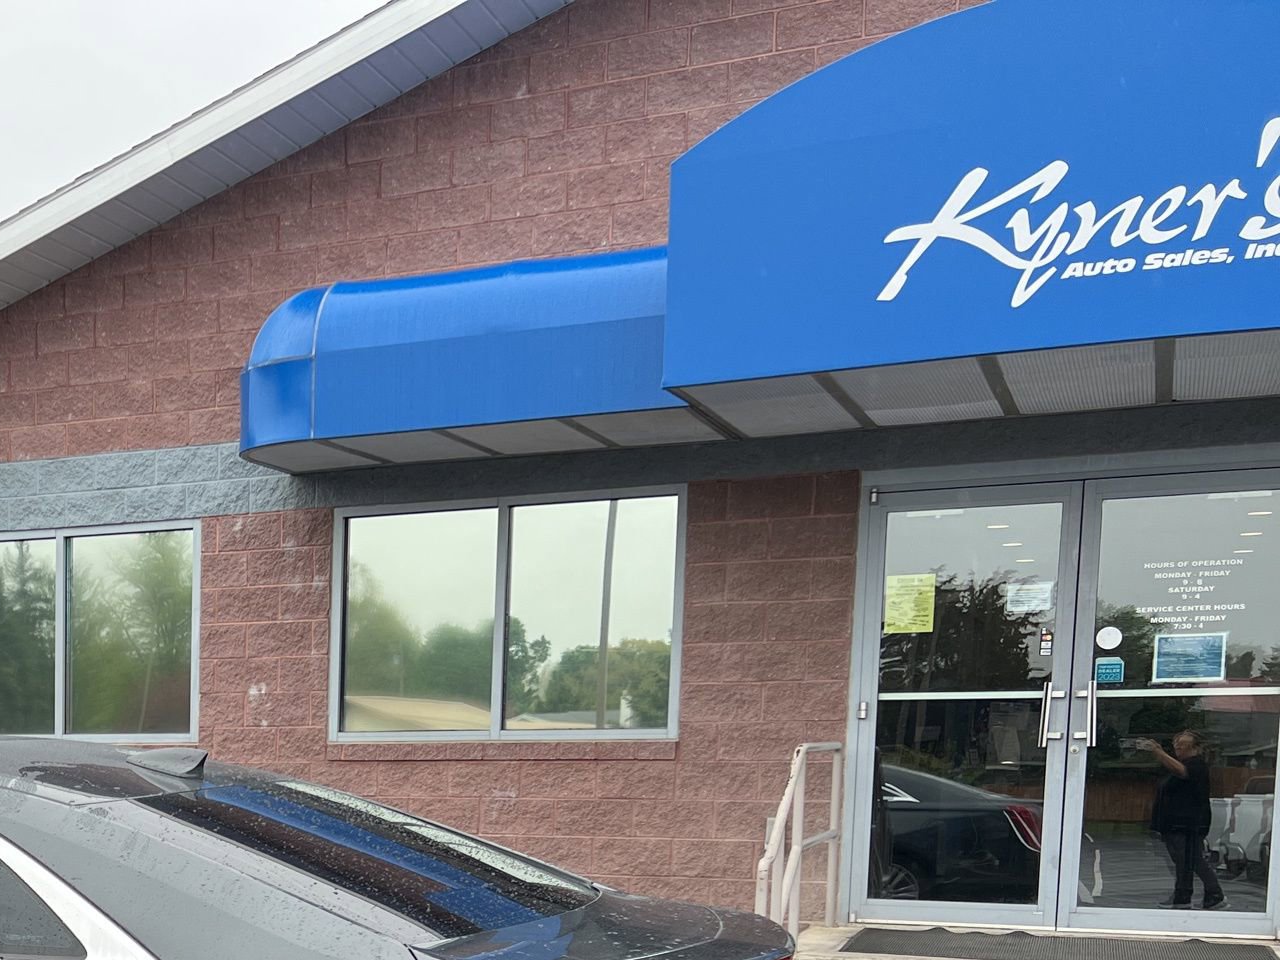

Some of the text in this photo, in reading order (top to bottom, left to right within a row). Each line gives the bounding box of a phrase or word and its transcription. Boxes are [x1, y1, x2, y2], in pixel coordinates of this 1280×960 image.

[1060, 258, 1136, 279] Auto
[1142, 247, 1235, 270] Sales,
[1143, 561, 1175, 569] HOURS
[1191, 558, 1243, 567] OPERATION
[1154, 571, 1192, 579] MONDAY
[1167, 585, 1215, 593] SATURDAY
[1136, 605, 1174, 613] SERVICE
[1150, 615, 1188, 623] MONDAY
[1194, 614, 1227, 622] FRIDAY
[1098, 673, 1120, 681] 2023
